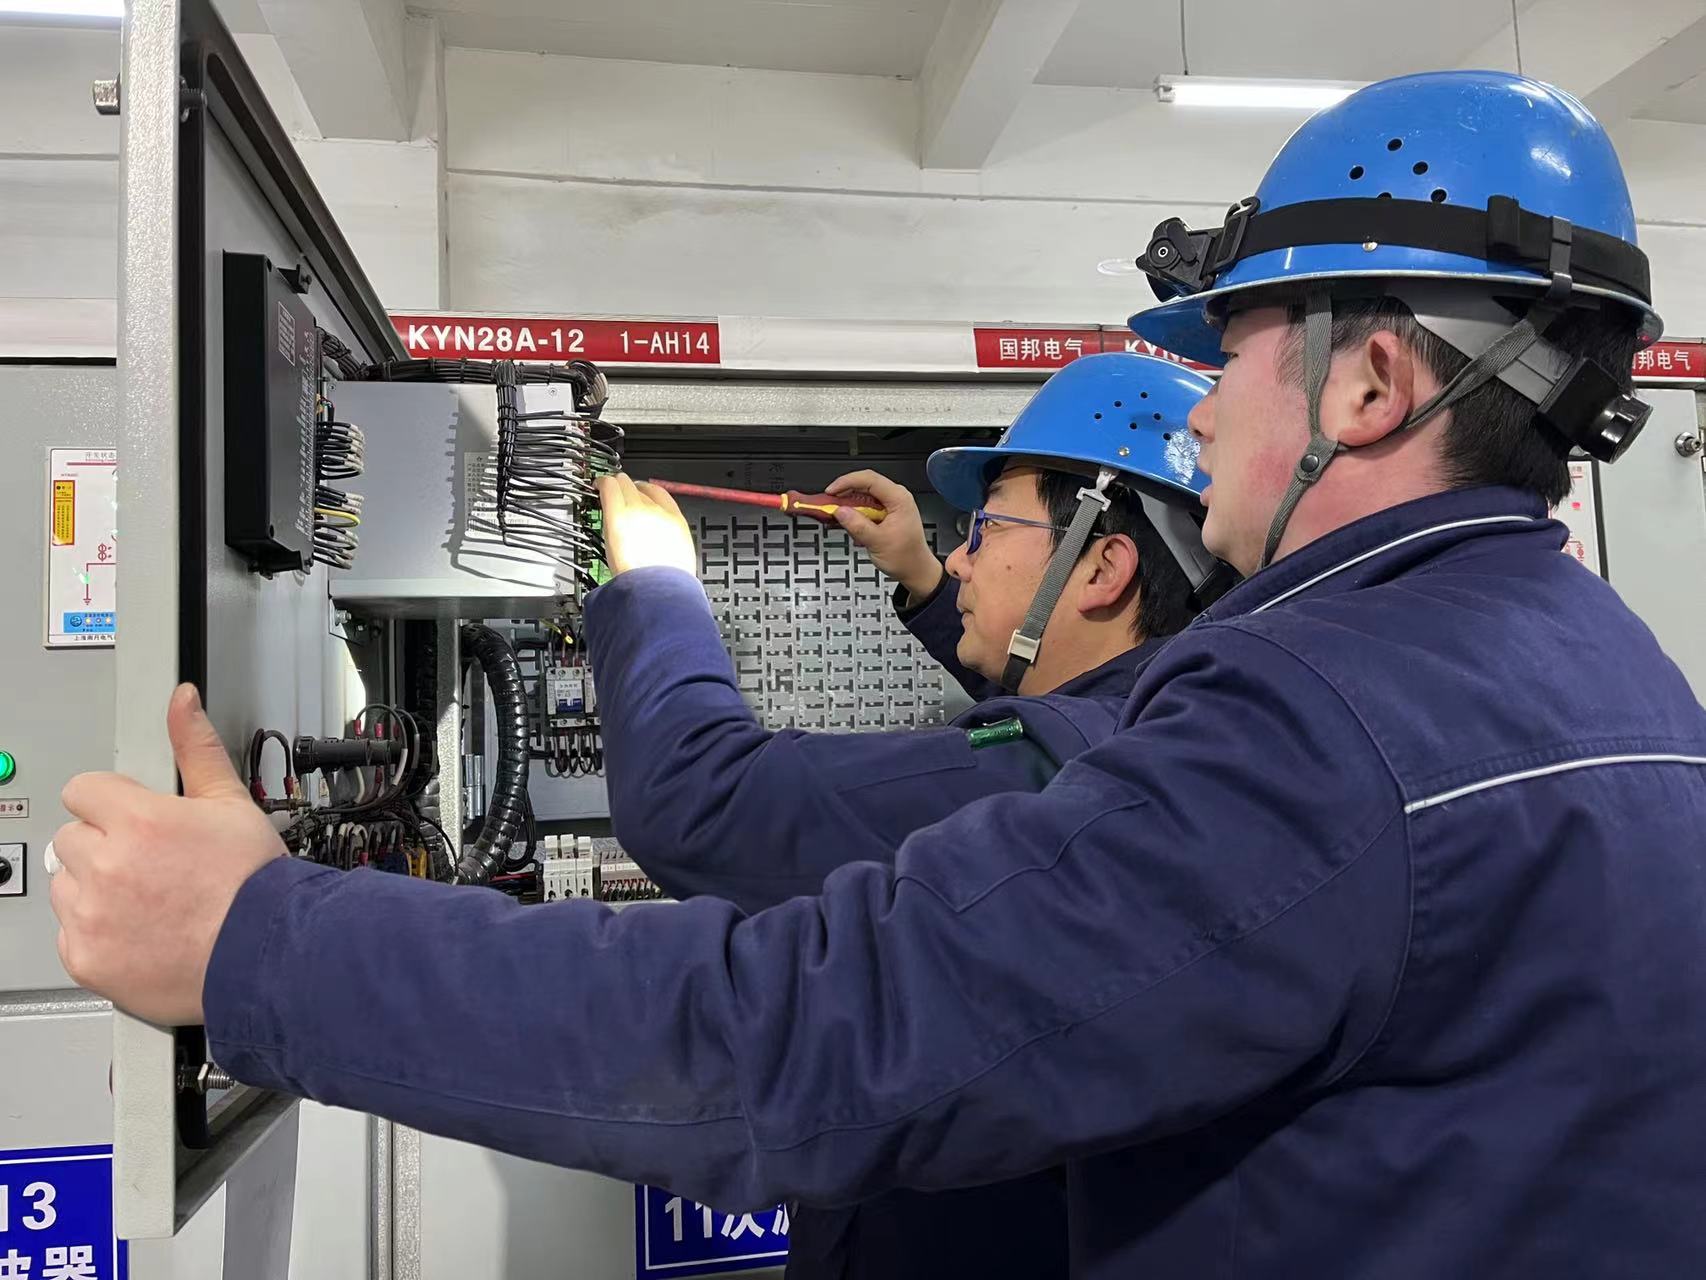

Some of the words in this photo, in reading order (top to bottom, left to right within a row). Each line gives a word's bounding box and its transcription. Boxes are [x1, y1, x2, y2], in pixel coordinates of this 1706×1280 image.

[408, 324, 584, 353] KYN28A-12
[620, 331, 710, 354] 1-AH14
[999, 338, 1083, 361] 国邦电气
[1632, 350, 1692, 371] 邦电气
